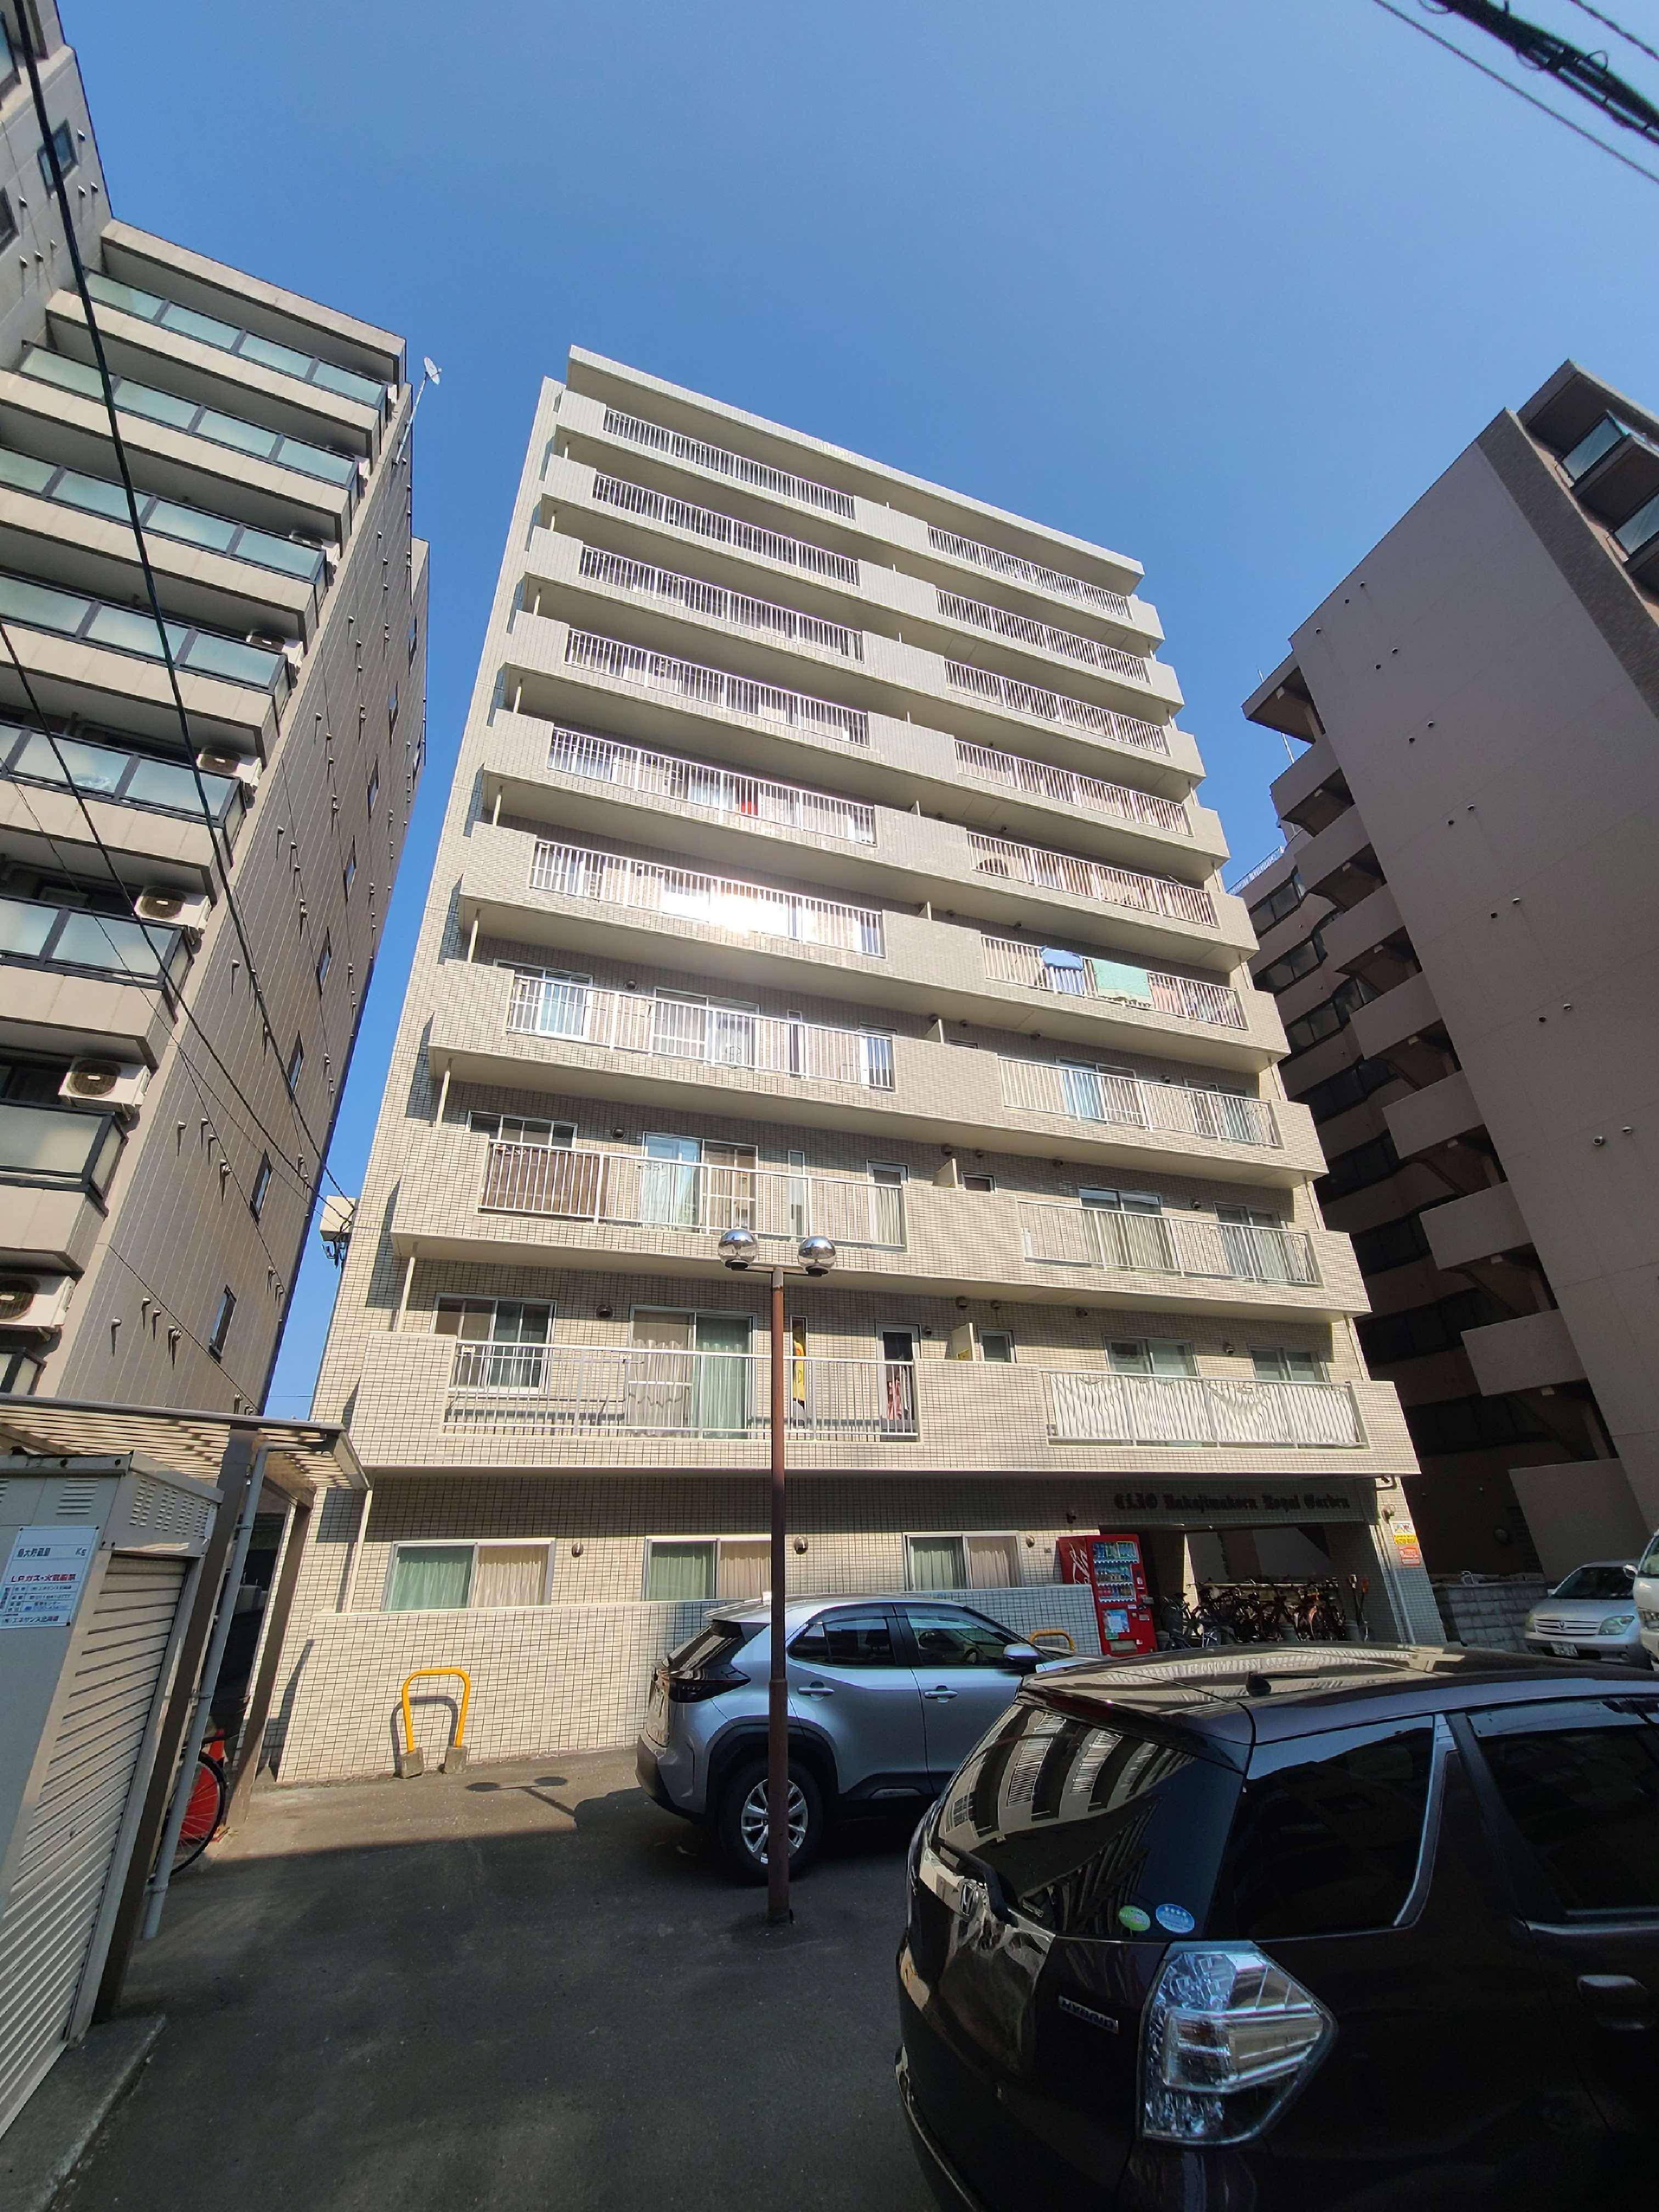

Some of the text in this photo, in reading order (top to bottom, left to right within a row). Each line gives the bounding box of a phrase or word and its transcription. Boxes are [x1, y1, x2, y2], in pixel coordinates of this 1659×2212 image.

[1262, 1493, 1300, 1513] Royal
[1304, 1493, 1350, 1510] Garden
[1061, 1999, 1115, 2030] HYBRID
